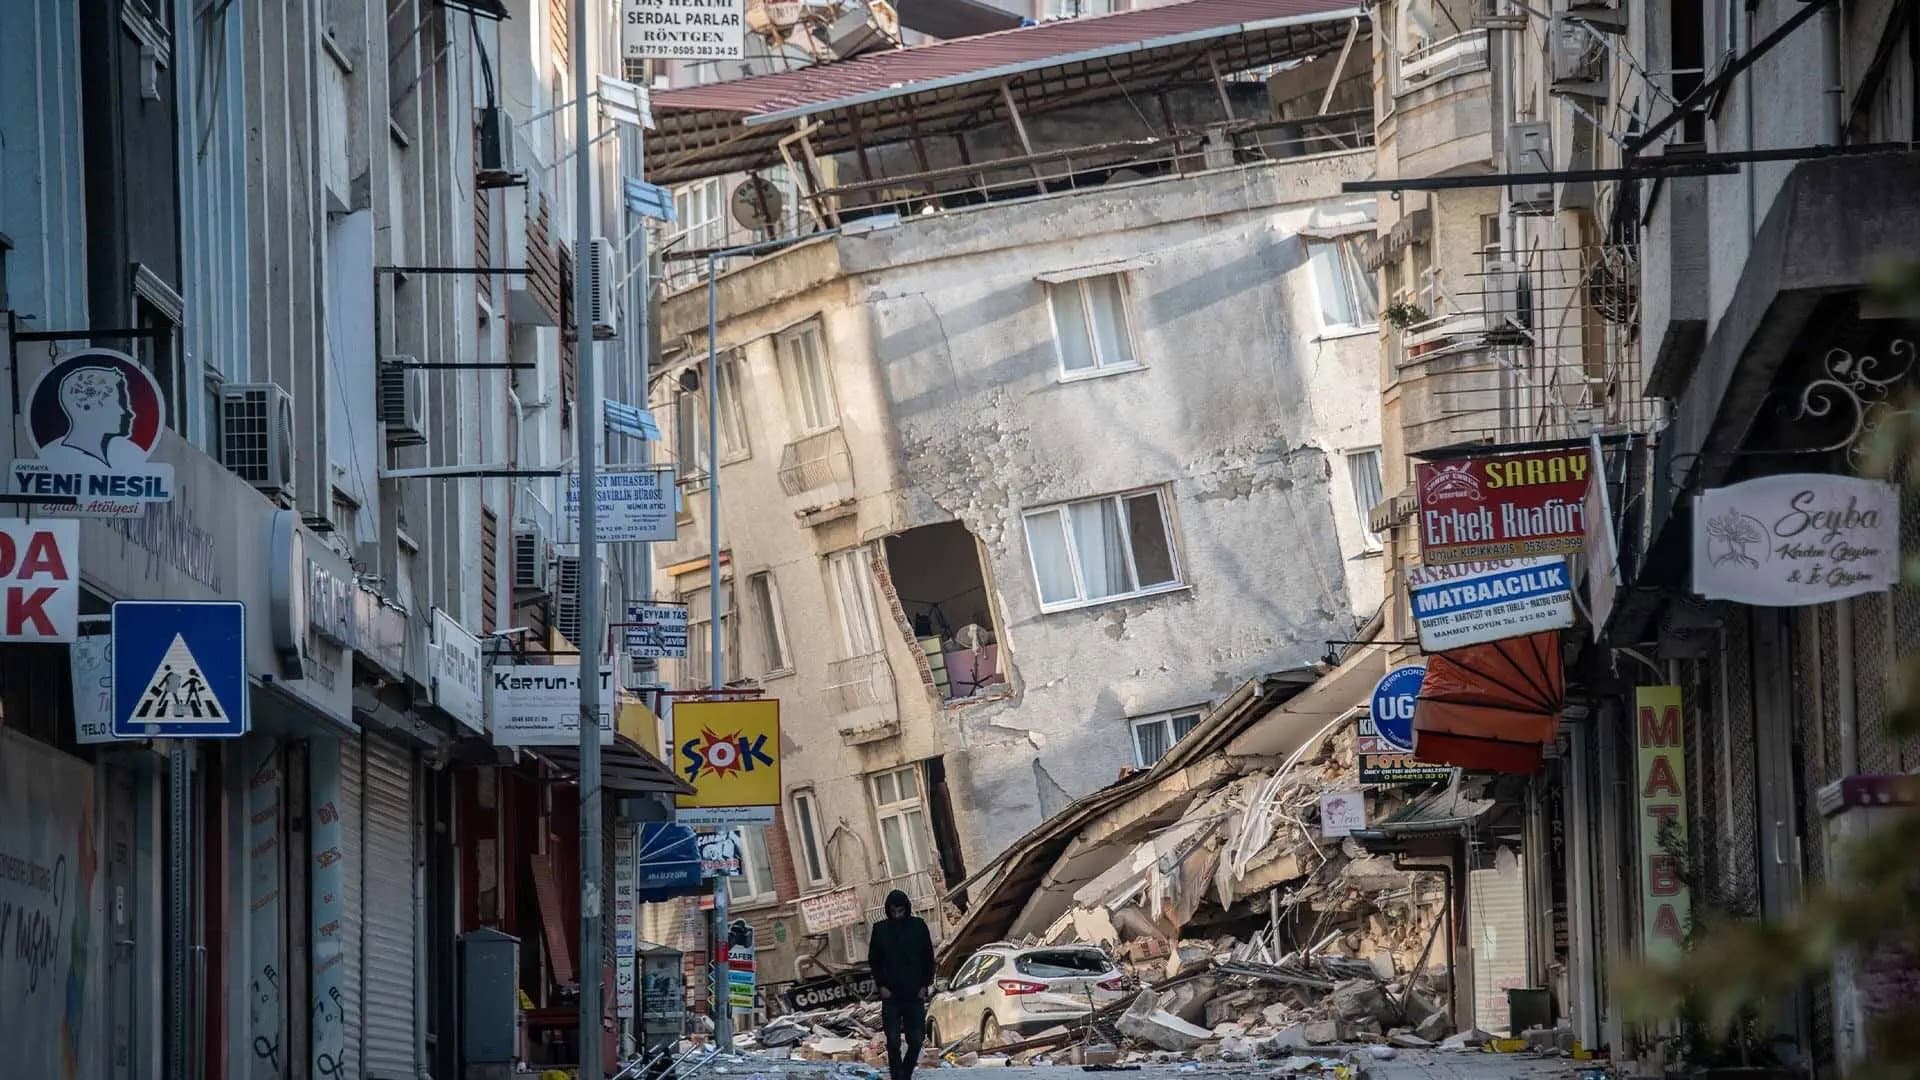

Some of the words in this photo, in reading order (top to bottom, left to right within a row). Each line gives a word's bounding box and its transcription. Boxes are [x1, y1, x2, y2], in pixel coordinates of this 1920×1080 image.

[628, 12, 680, 25] SERDAL
[686, 13, 739, 26] PARLAR
[644, 28, 724, 42] RÖNTGEN
[1485, 455, 1588, 489] SARAY
[1425, 506, 1495, 546] Erkek
[1773, 490, 1881, 545] Seyba
[1416, 567, 1565, 613] MATBAACILIK
[1787, 569, 1802, 583] &
[1433, 626, 1470, 639] MAHMUT
[682, 733, 775, 784] ŞOK
[795, 983, 847, 1007] GÖKSEL
